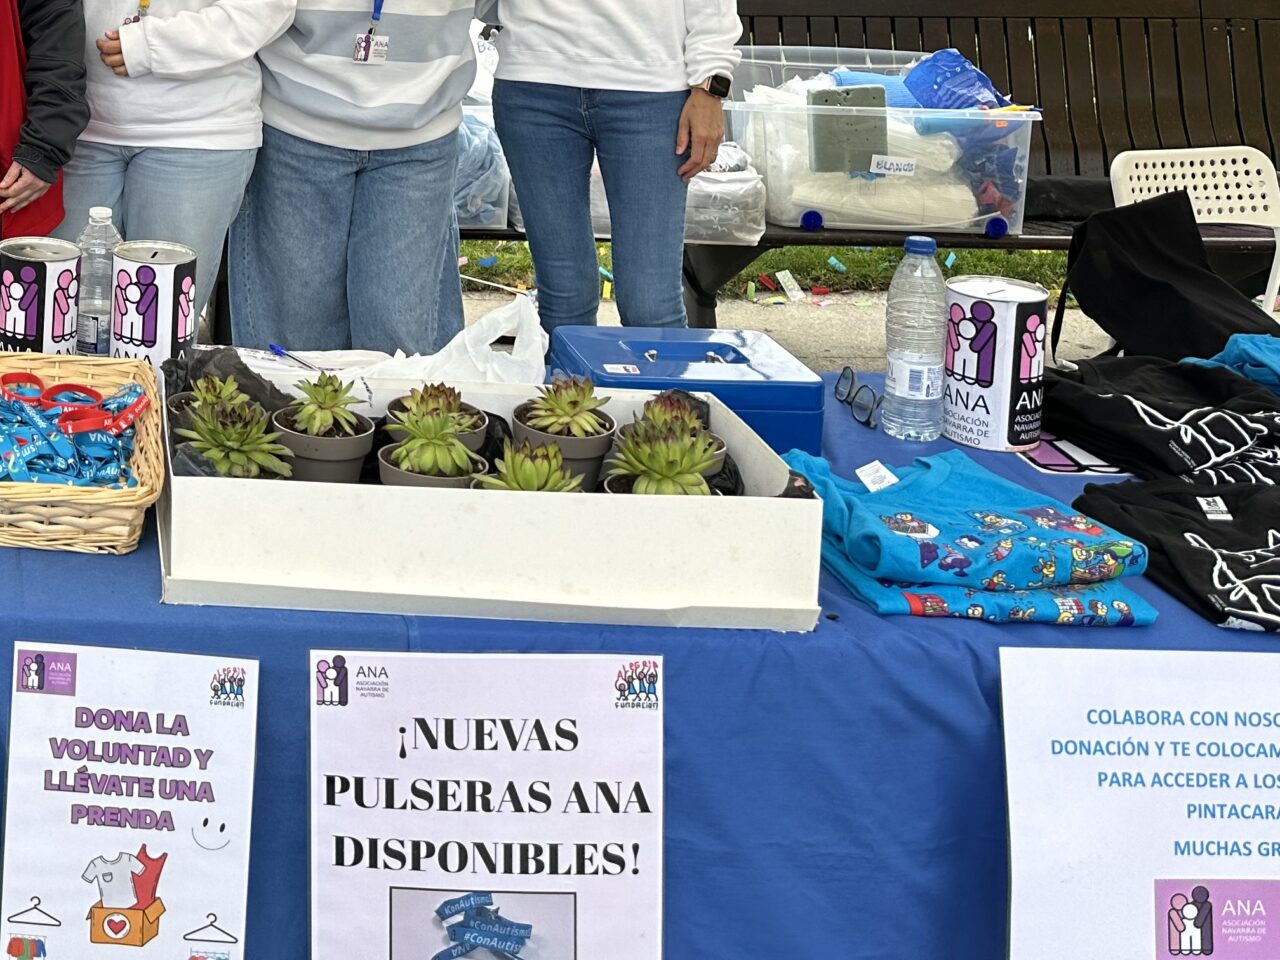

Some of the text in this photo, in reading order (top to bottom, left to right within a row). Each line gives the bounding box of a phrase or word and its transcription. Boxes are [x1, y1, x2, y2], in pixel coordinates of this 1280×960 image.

[943, 384, 991, 415] ANA
[976, 427, 990, 439] DE
[49, 661, 72, 672] ANA
[356, 666, 389, 678] ANA
[75, 706, 190, 737] DONA LA
[1086, 709, 1185, 726] COLABORA
[1190, 710, 1229, 727] CON
[398, 717, 580, 759] ¡NUEVAS
[1051, 737, 1150, 757] DONACIÓN
[1154, 741, 1166, 757] Y
[1170, 741, 1191, 757] TE
[49, 737, 214, 770] VOLUNTAD Y
[44, 765, 215, 803] LLÉVATE UNA
[1098, 772, 1146, 788] PARA
[1151, 772, 1230, 789] ACCEDER
[1235, 773, 1249, 788] A
[322, 774, 654, 814] PULSERAS ANA
[71, 803, 175, 832] PRENDA
[331, 835, 641, 876] DISPONIBLES!
[1174, 840, 1280, 857] MUCHAS GR
[1222, 899, 1266, 916] ANA
[1222, 918, 1266, 926] ASOCIACIÓN
